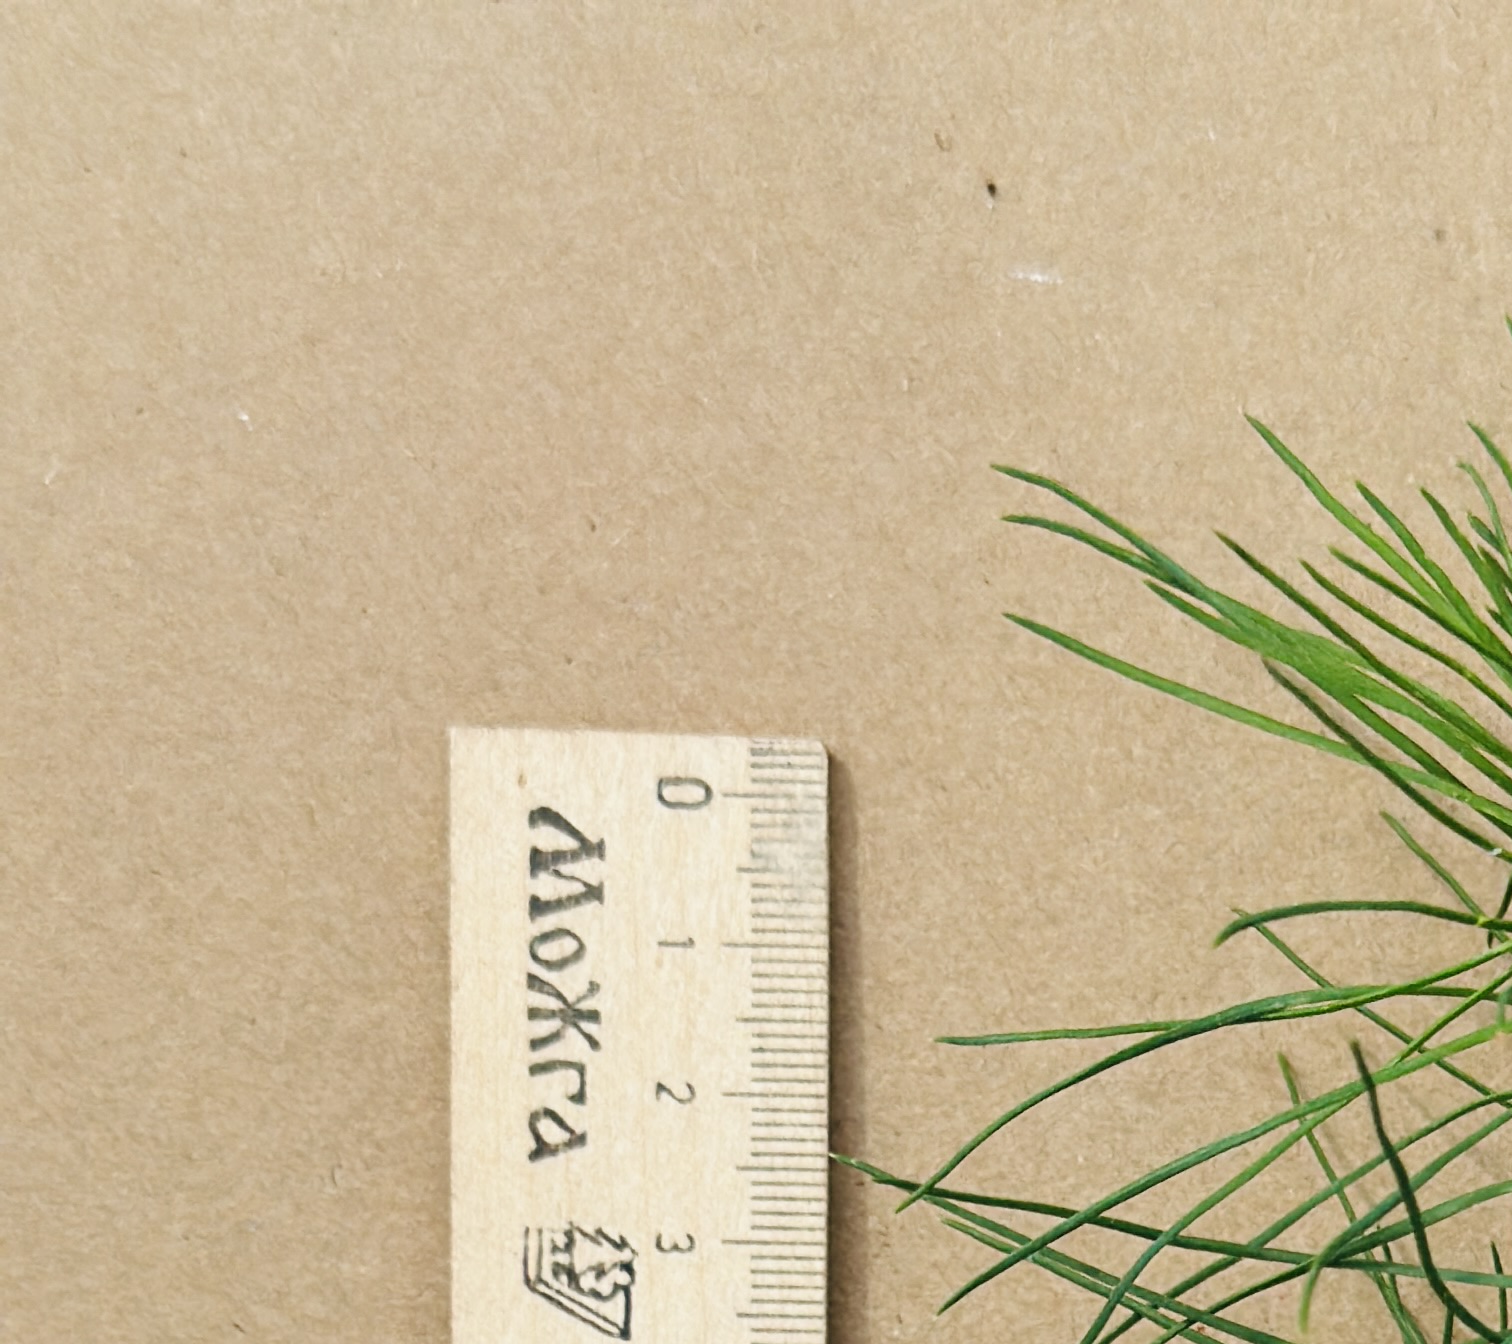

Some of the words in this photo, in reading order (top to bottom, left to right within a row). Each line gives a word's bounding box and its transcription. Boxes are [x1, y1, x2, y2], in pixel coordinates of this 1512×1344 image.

[656, 775, 714, 811] 0
[657, 936, 696, 949] 1
[655, 1080, 697, 1105] 2
[655, 1232, 696, 1254] 3
